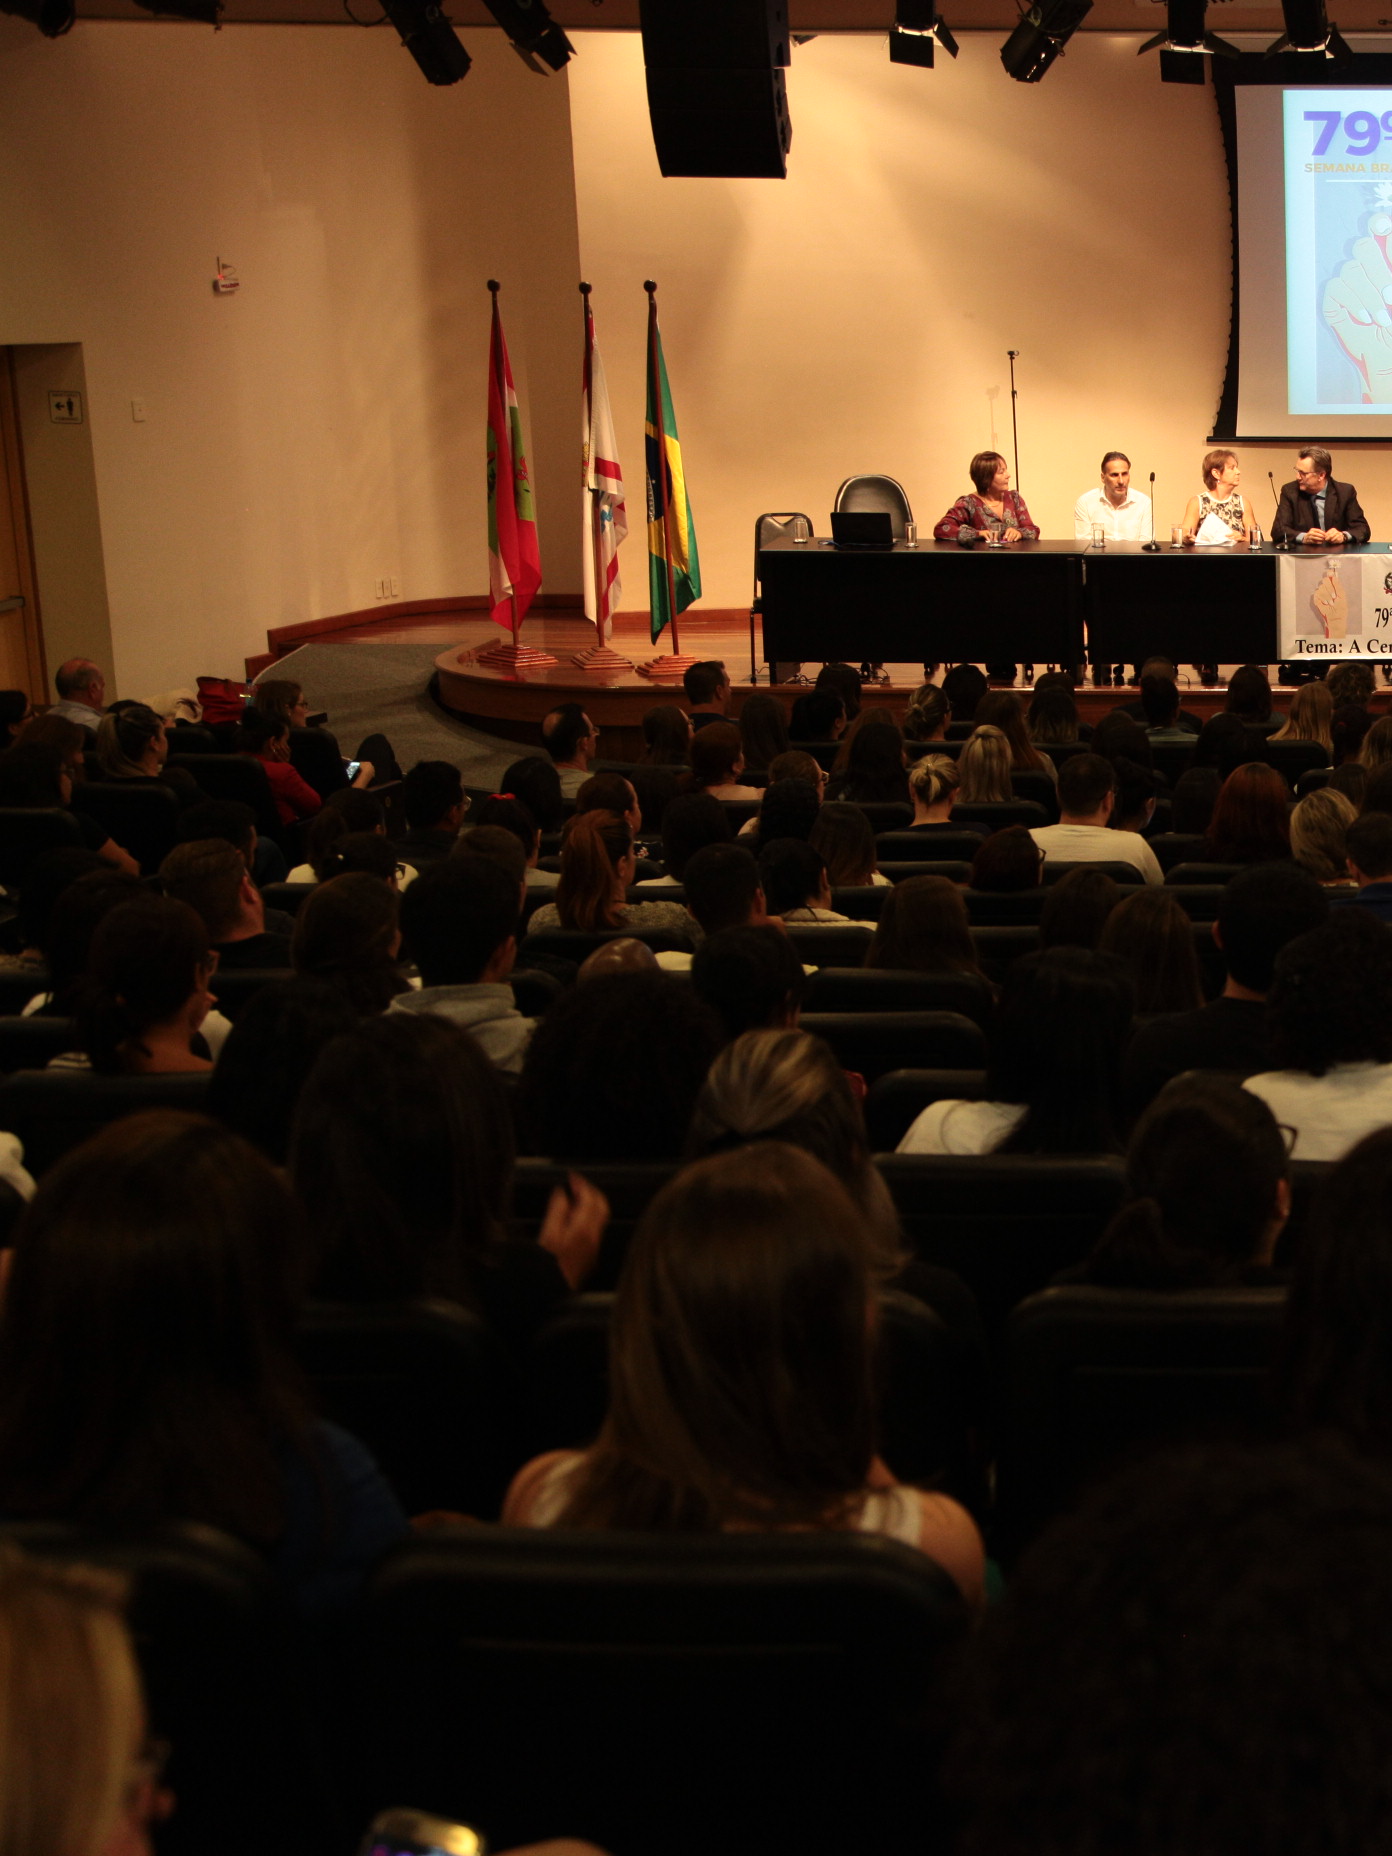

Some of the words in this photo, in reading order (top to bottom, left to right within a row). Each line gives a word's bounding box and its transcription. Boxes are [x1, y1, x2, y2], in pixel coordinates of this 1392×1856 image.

[1304, 163, 1366, 173] SEMANA
[1295, 639, 1343, 654] Tema:
[1348, 639, 1361, 654] A
